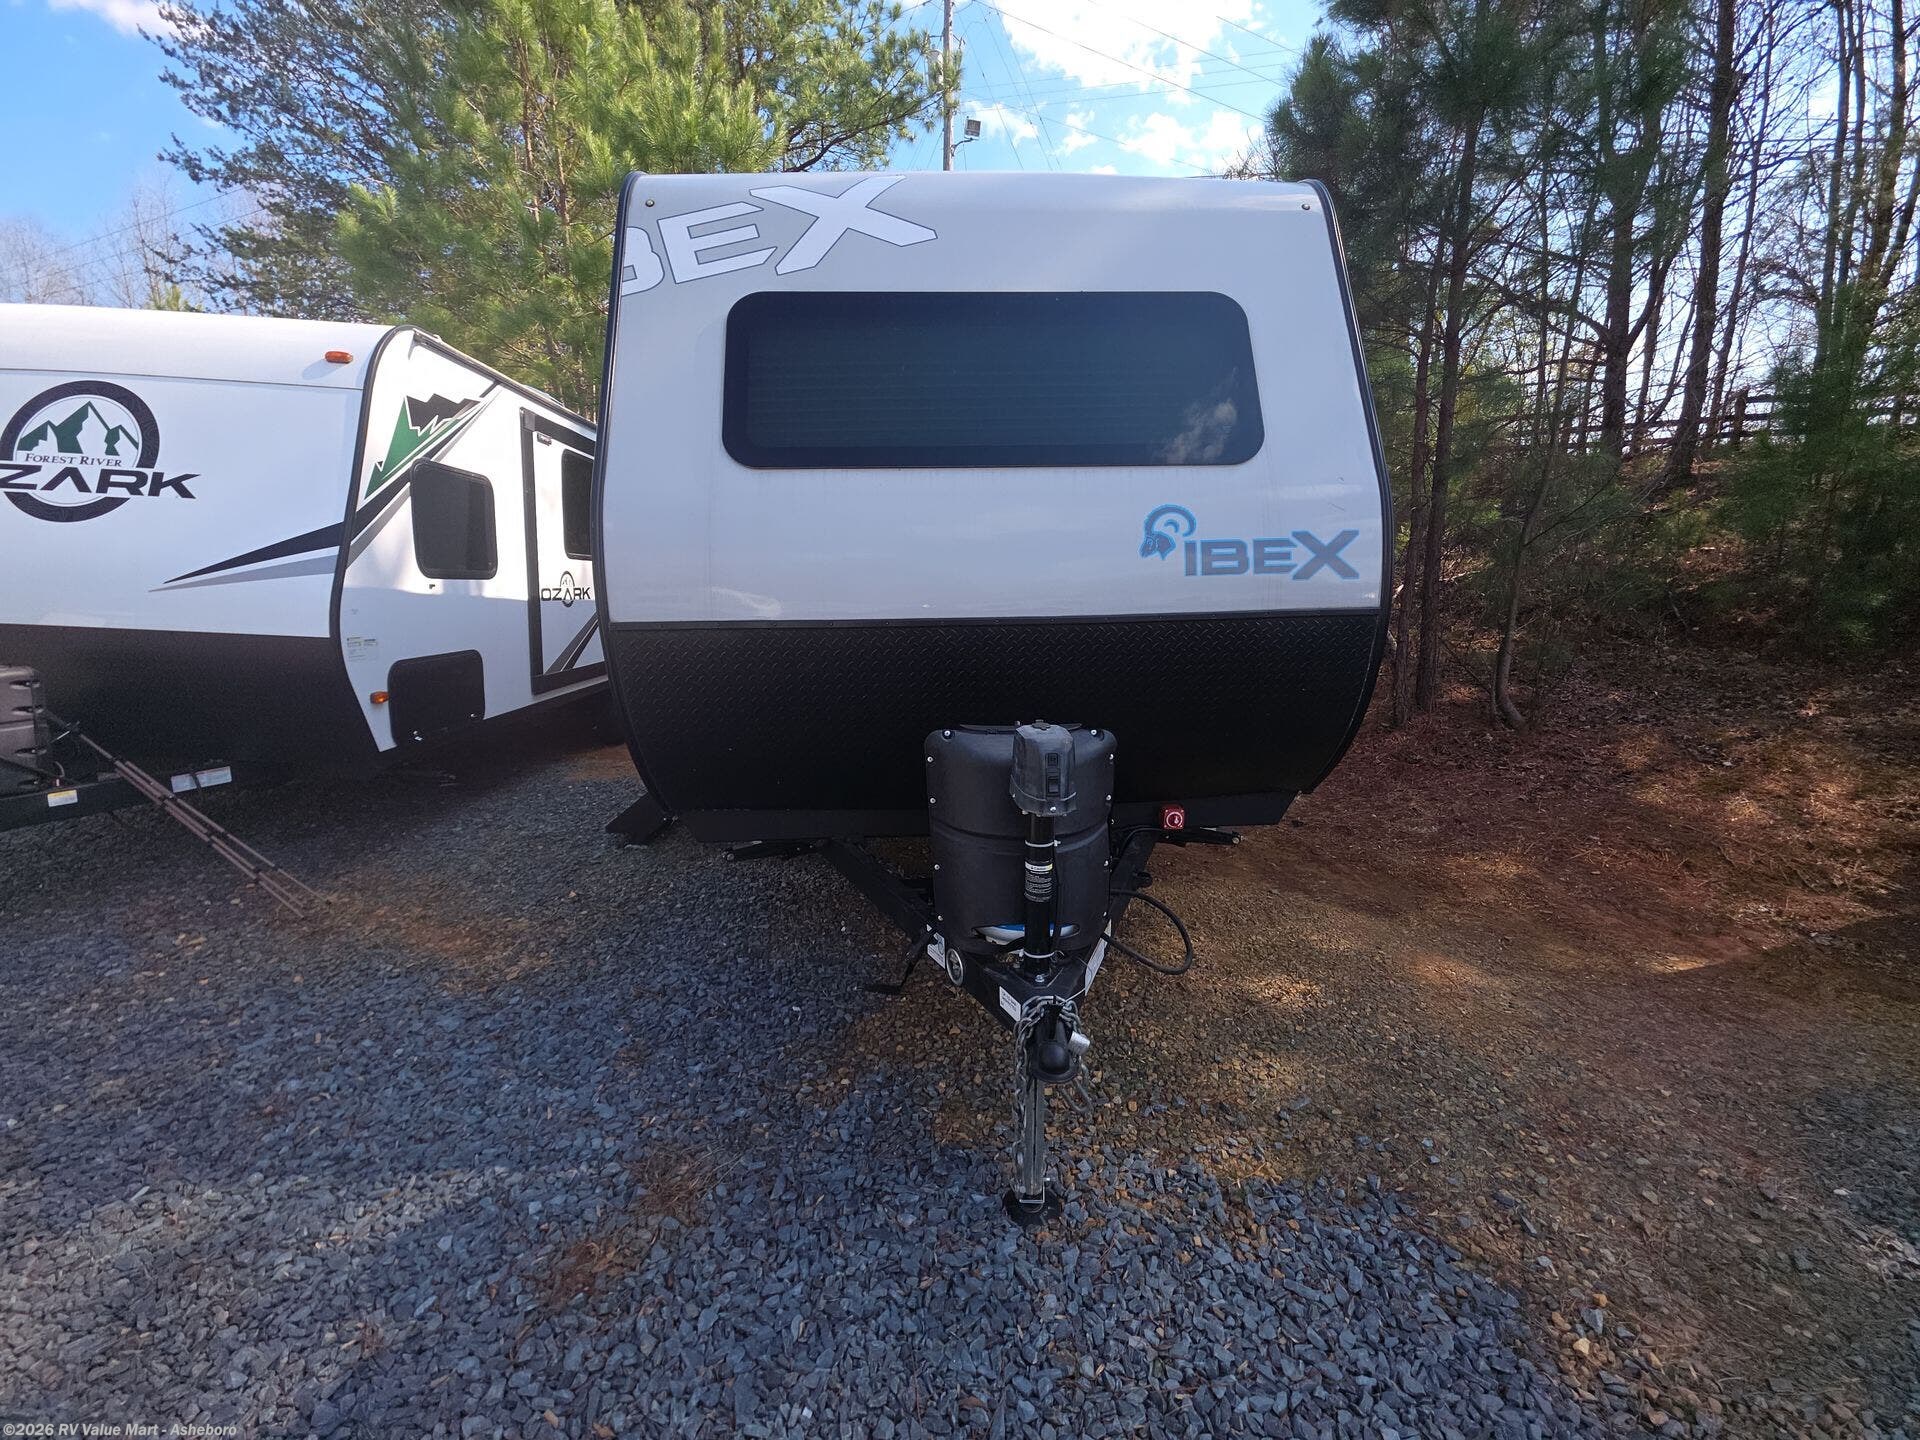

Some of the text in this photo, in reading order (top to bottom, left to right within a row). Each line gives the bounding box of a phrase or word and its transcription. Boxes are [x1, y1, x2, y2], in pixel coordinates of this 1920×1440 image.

[25, 453, 122, 467] FOREST RIVER
[1184, 529, 1360, 580] IBEX
[541, 587, 591, 601] OZARK
